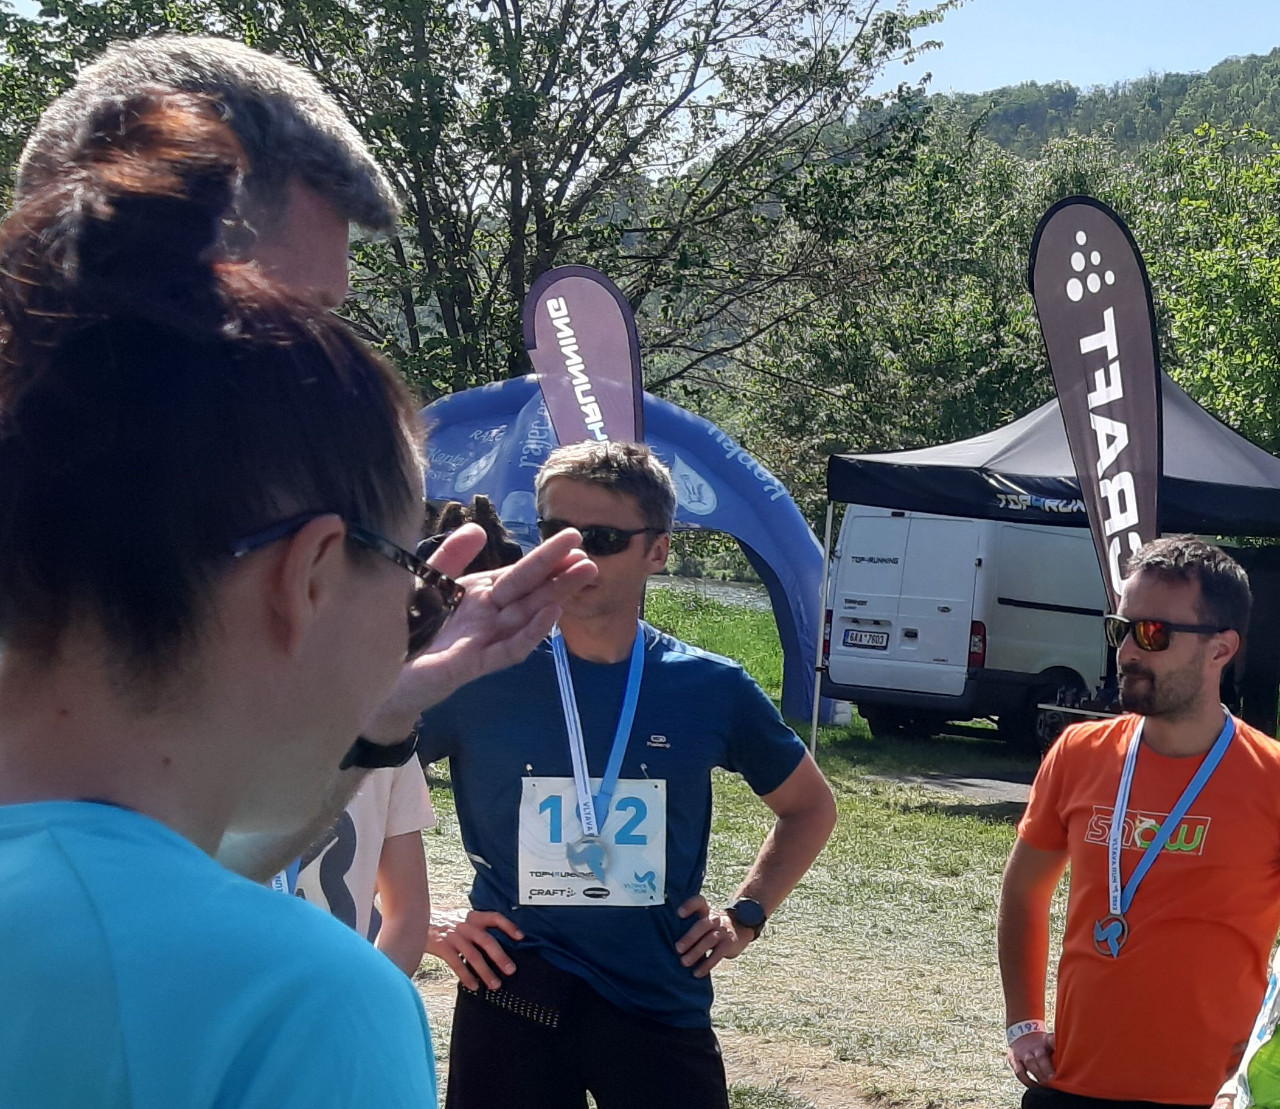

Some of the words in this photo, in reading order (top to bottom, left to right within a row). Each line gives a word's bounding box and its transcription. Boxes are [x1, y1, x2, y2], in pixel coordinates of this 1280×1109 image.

[997, 493, 1086, 513] TOP4RUN
[538, 794, 648, 845] 12
[583, 801, 594, 832] VLTAVA
